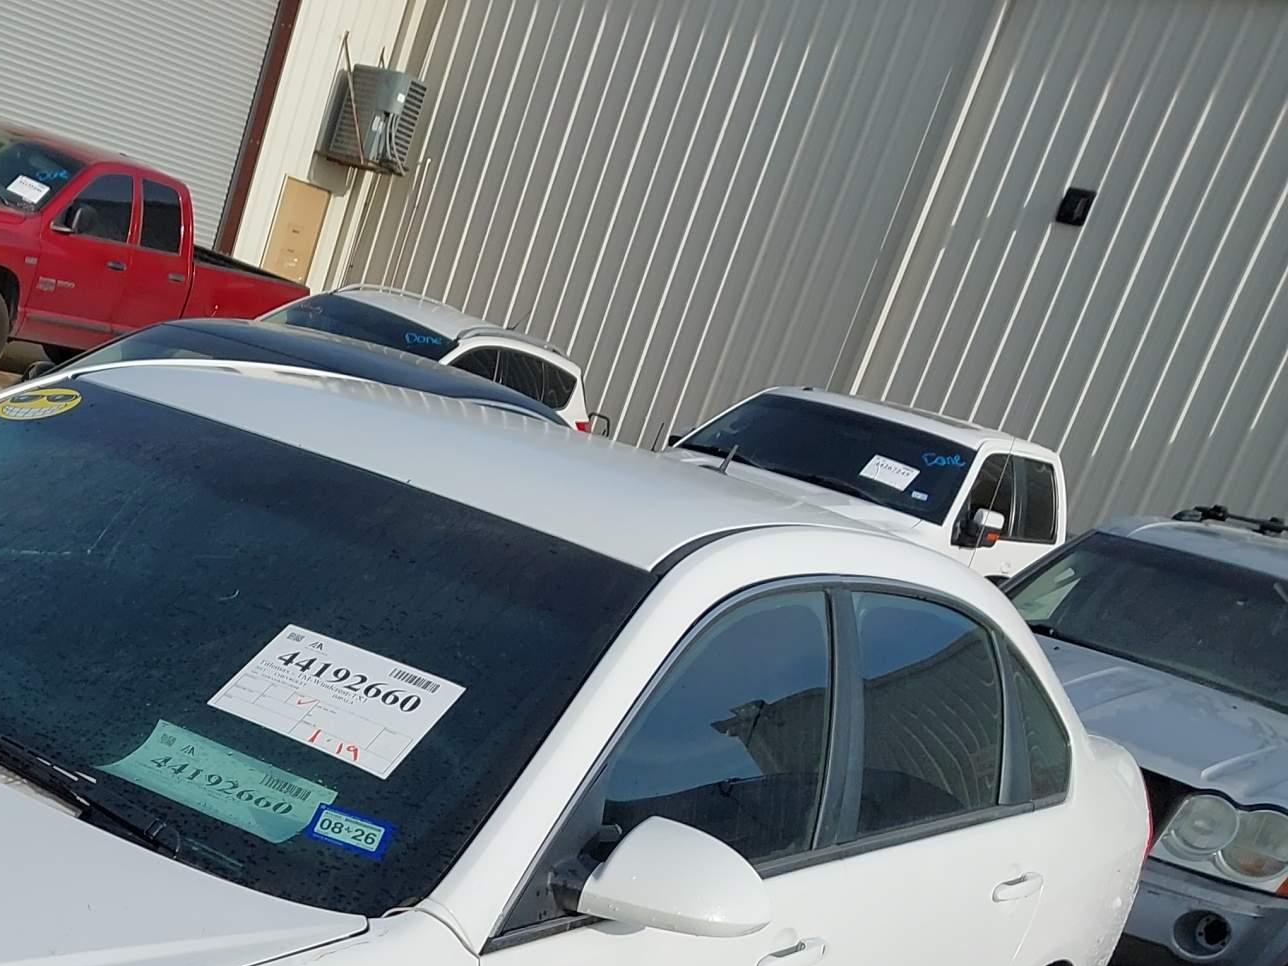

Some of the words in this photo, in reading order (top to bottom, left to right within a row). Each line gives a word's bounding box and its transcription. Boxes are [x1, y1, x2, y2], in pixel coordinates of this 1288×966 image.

[404, 331, 442, 346] Done
[277, 651, 422, 713] 44192660
[150, 756, 293, 815] 44192660
